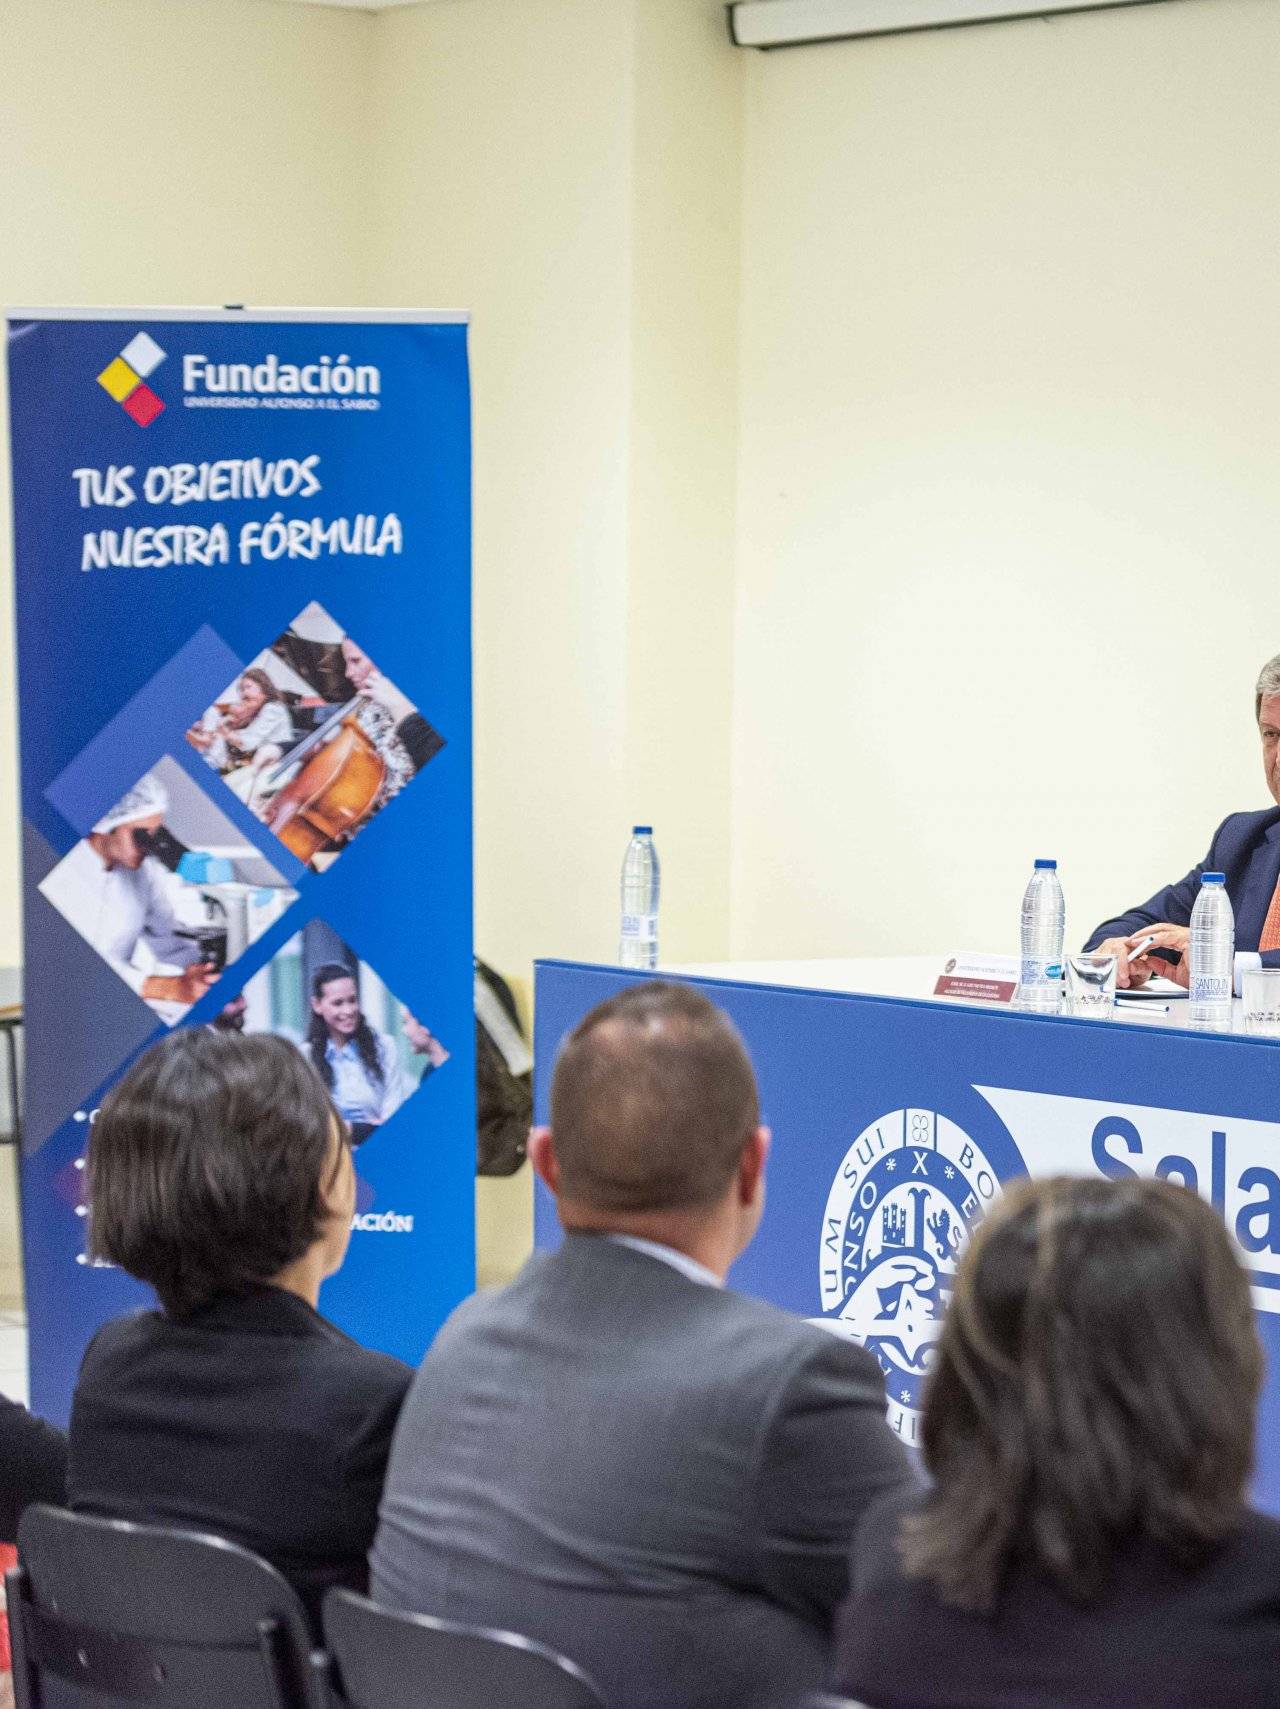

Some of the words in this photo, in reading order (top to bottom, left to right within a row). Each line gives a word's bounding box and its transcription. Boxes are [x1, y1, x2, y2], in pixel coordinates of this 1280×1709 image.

[182, 354, 381, 395] Fundación
[73, 465, 137, 508] TUS
[143, 455, 322, 506] OBJETIVOS
[82, 522, 229, 572] NUESTRA
[239, 513, 402, 566] FÓRMULA
[843, 1127, 886, 1190] SUI
[911, 1151, 929, 1176] X
[349, 1210, 415, 1233] ACIÓN
